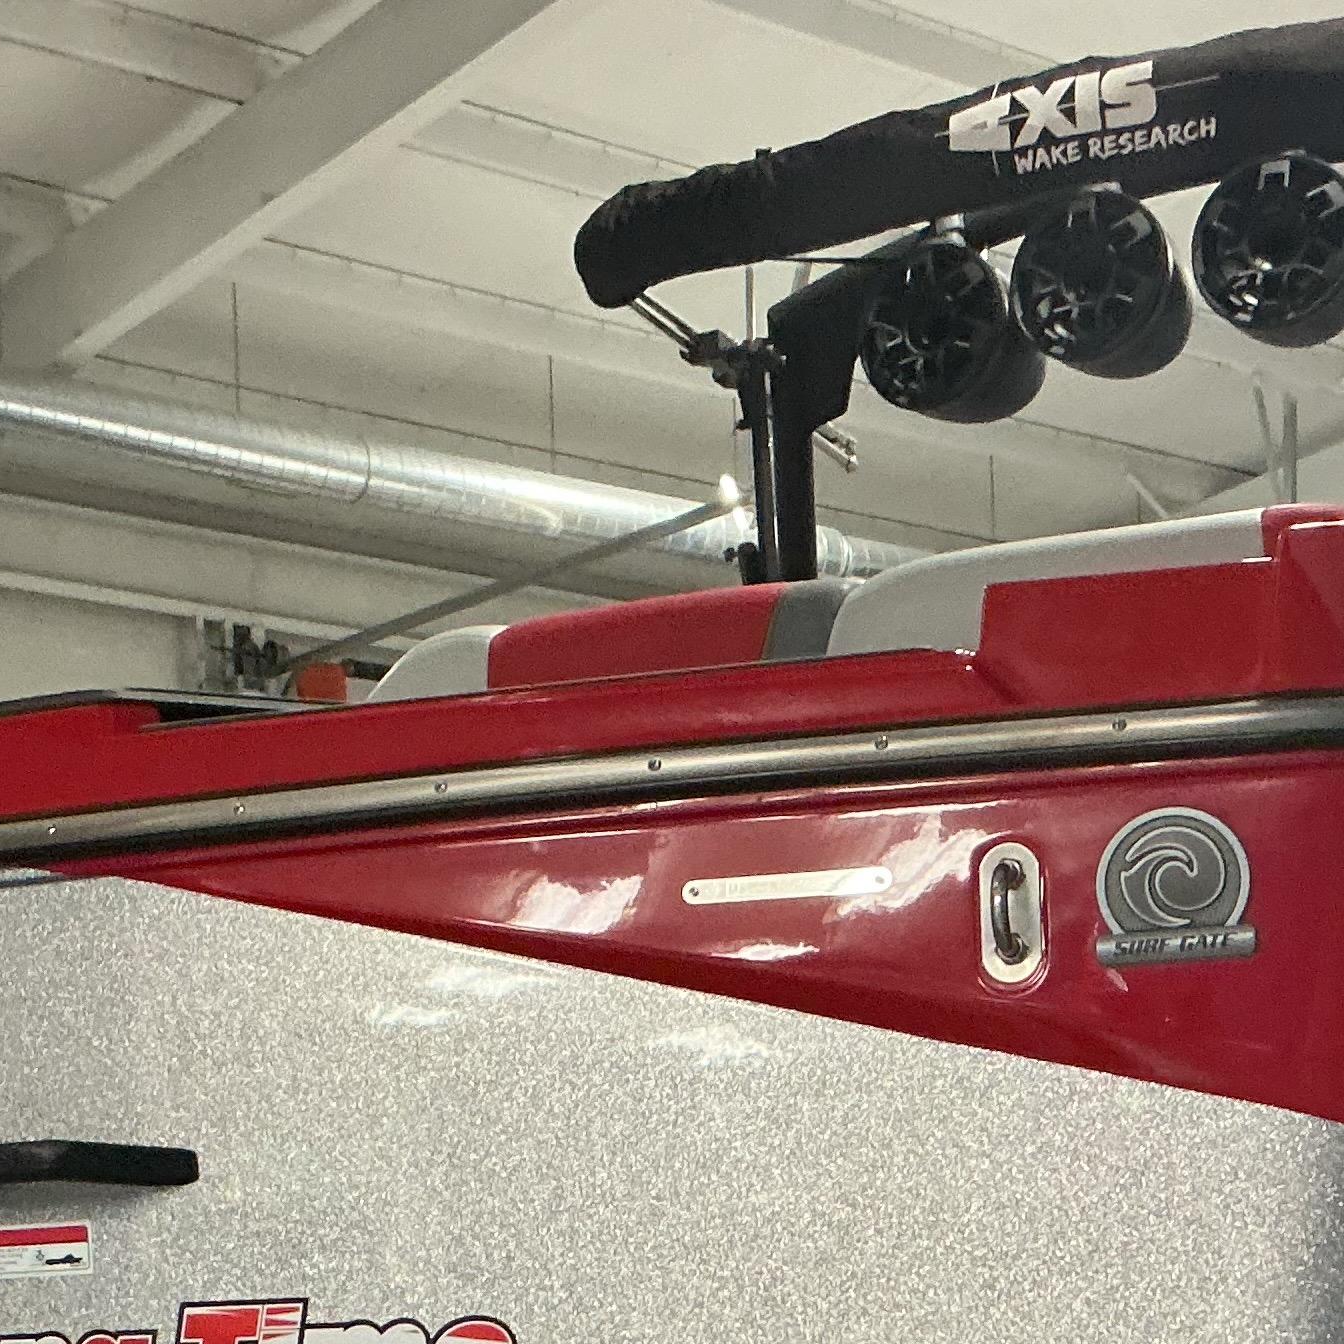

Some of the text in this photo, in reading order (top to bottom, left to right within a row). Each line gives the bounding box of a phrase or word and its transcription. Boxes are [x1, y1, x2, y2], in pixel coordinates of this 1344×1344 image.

[947, 59, 1158, 152] AXIS
[1013, 115, 1218, 175] WAKE RESEARCH
